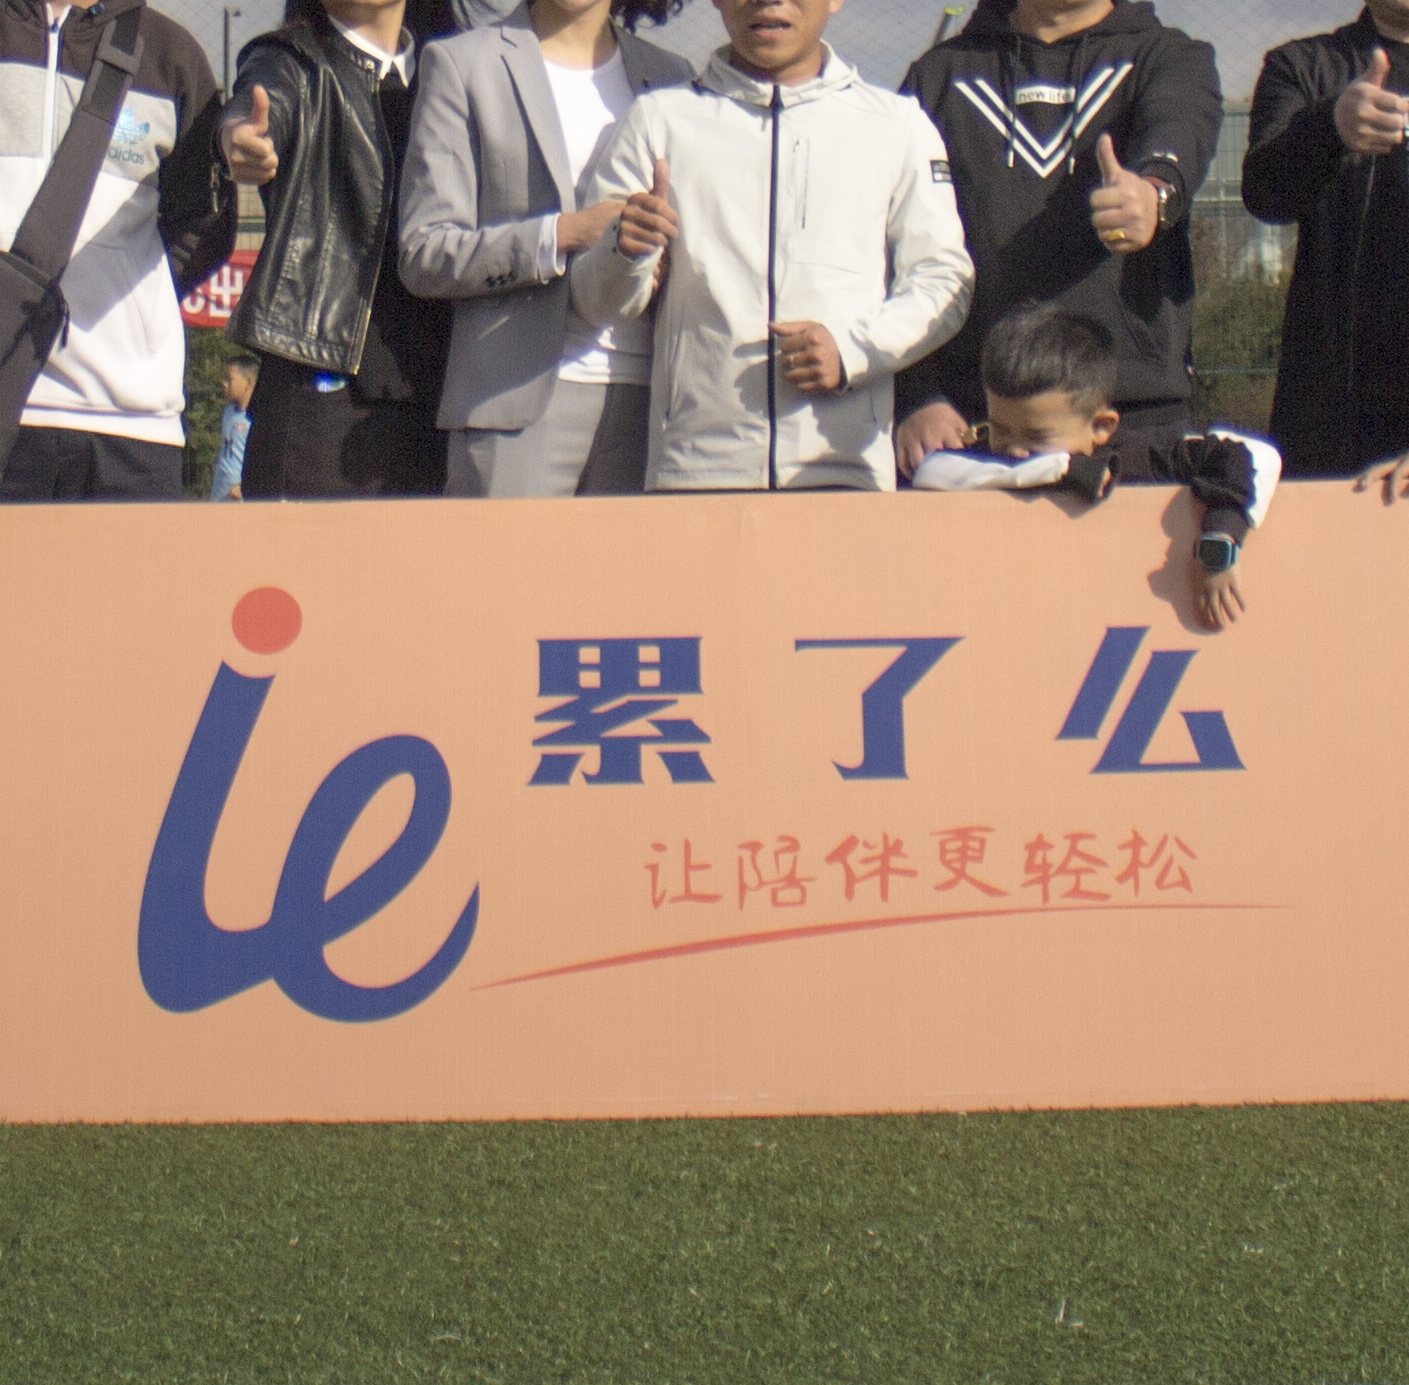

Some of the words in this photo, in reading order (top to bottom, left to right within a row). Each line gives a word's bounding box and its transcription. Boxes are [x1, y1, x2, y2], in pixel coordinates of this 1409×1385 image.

[107, 145, 144, 165] didas
[528, 627, 1245, 785] 累了么
[644, 826, 1198, 910] 让陪伴更轻松
